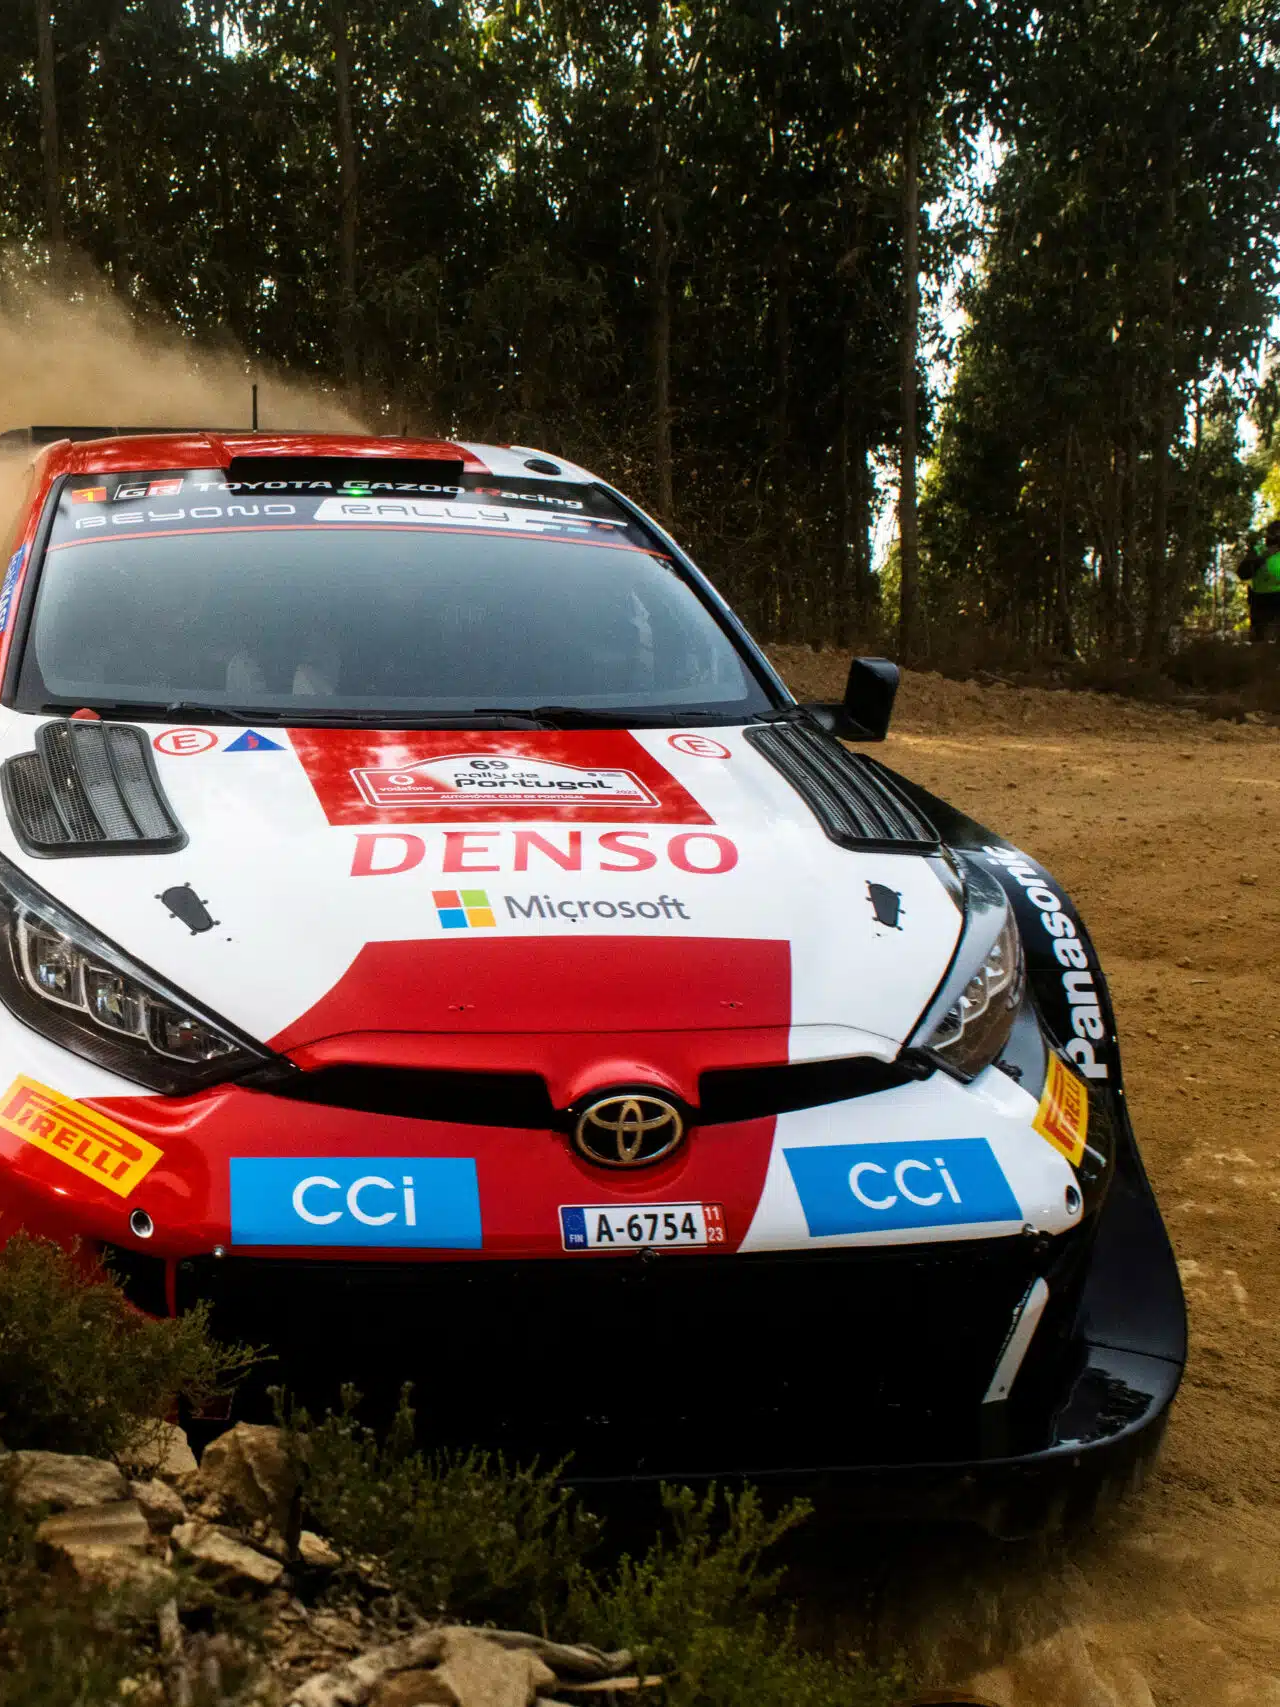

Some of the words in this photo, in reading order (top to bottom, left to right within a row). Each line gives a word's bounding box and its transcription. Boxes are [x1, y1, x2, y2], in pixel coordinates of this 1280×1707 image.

[117, 484, 181, 499] GR
[193, 481, 333, 492] TOYOTA
[342, 480, 466, 495] GAZOO
[475, 487, 584, 510] Racing
[75, 504, 297, 530] BEYOND
[341, 503, 511, 522] RALLY
[172, 734, 199, 750] E
[684, 740, 717, 753] E
[454, 771, 506, 779] rally
[469, 760, 509, 770] 69
[455, 779, 613, 790] Portugal
[350, 831, 740, 876] DENSO
[503, 894, 692, 920] Microsoft
[981, 845, 1109, 1080] Panasonic
[1, 1086, 144, 1181] PIRELLI
[848, 1157, 963, 1211] CCi
[292, 1175, 417, 1227] CCi
[703, 1206, 720, 1221] 11
[596, 1212, 698, 1243] A-6754
[707, 1227, 724, 1242] 23
[569, 1234, 585, 1243] FIN
